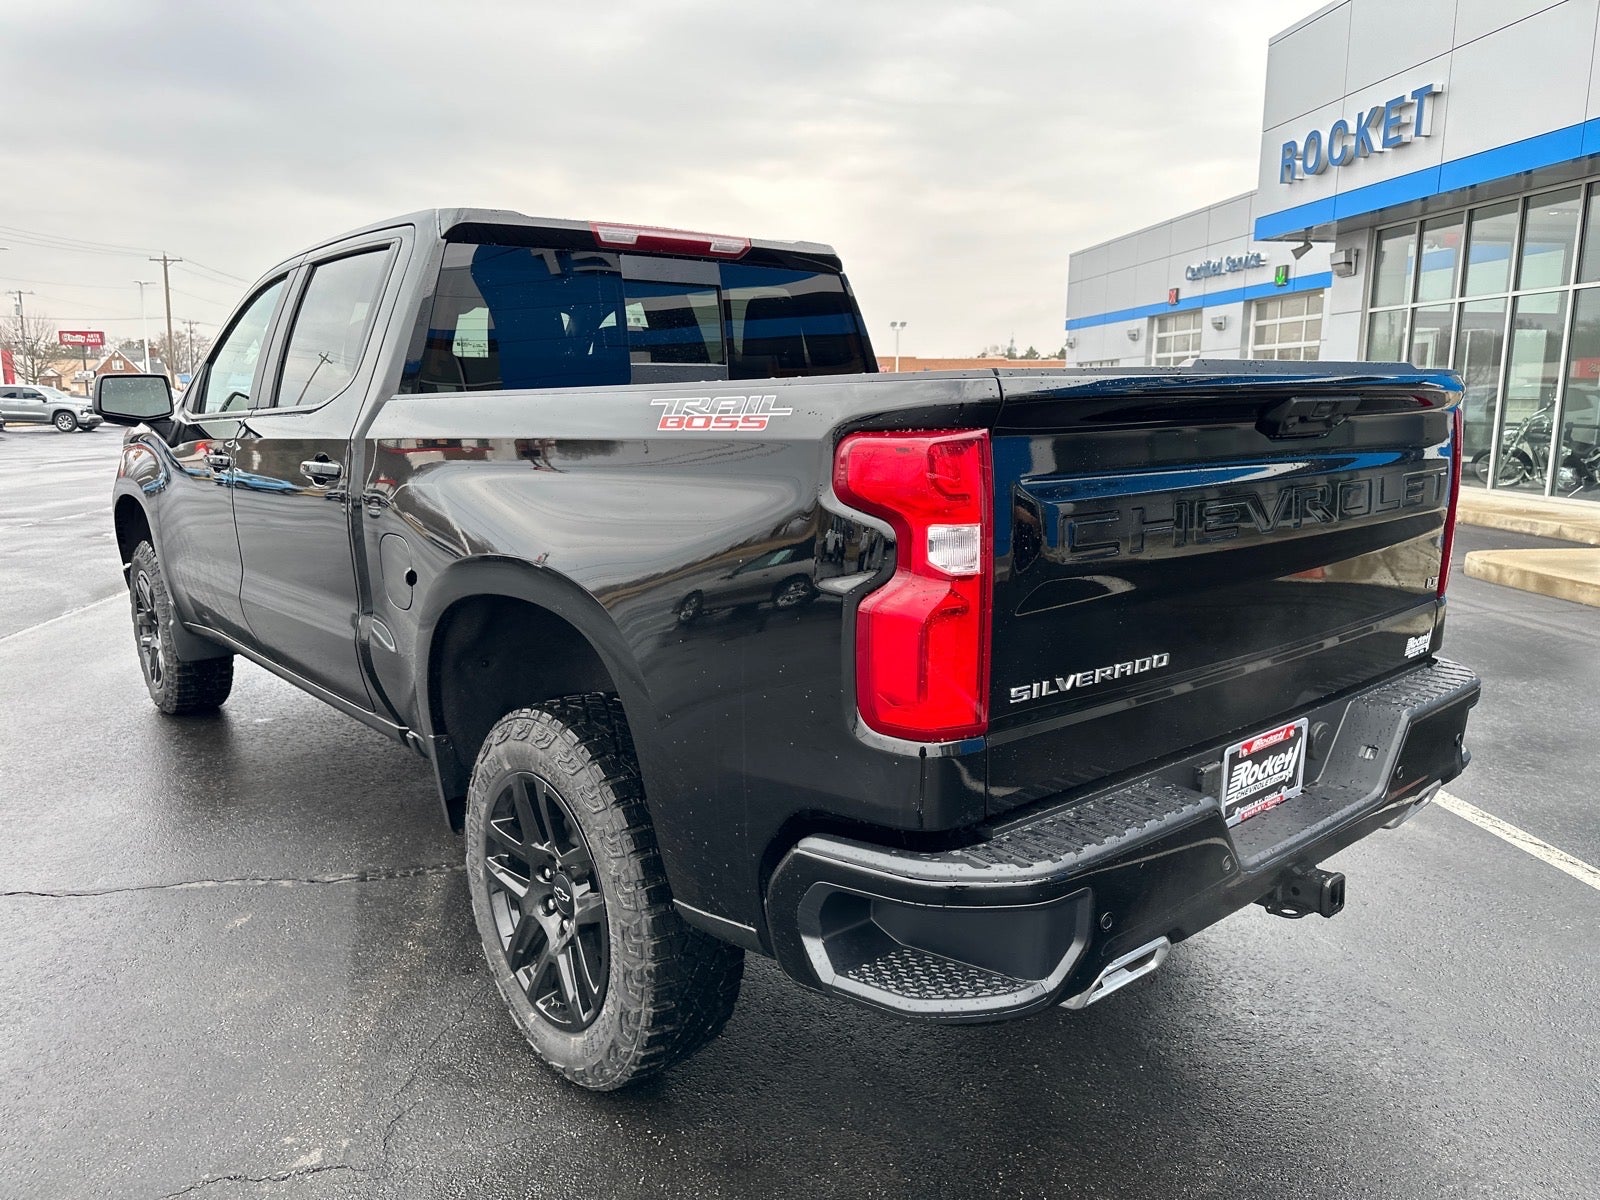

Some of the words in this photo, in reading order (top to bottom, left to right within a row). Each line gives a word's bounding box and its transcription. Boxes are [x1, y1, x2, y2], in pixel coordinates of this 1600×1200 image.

[1280, 83, 1440, 184] ROCKET
[1185, 257, 1224, 281] Certified
[1225, 252, 1263, 272] Service
[650, 395, 793, 416] TRAIL
[657, 414, 770, 431] BOSS
[1062, 468, 1447, 563] CHEVROLET
[1010, 653, 1170, 703] SILVERADO
[1228, 738, 1301, 791] Rocket
